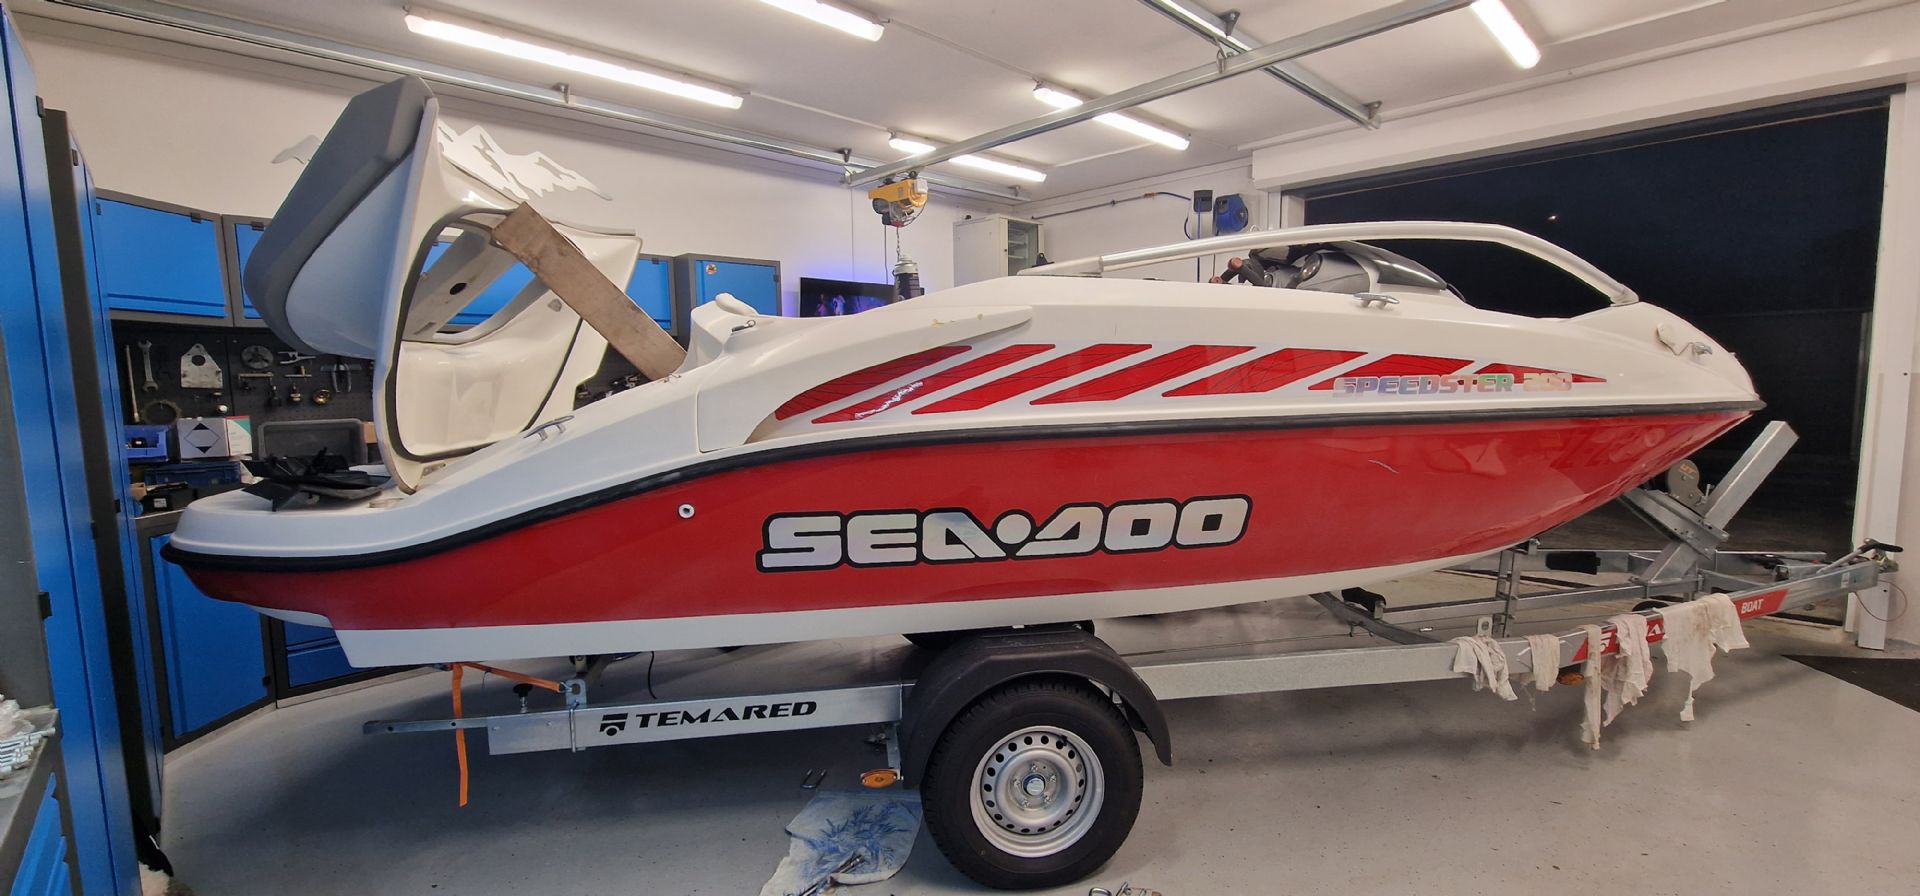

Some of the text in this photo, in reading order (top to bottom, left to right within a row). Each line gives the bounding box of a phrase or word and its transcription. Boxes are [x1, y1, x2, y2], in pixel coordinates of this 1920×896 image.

[1332, 374, 1514, 398] SPEEDSTER
[1741, 599, 1764, 614] BOAT
[636, 701, 817, 728] TEMARED
